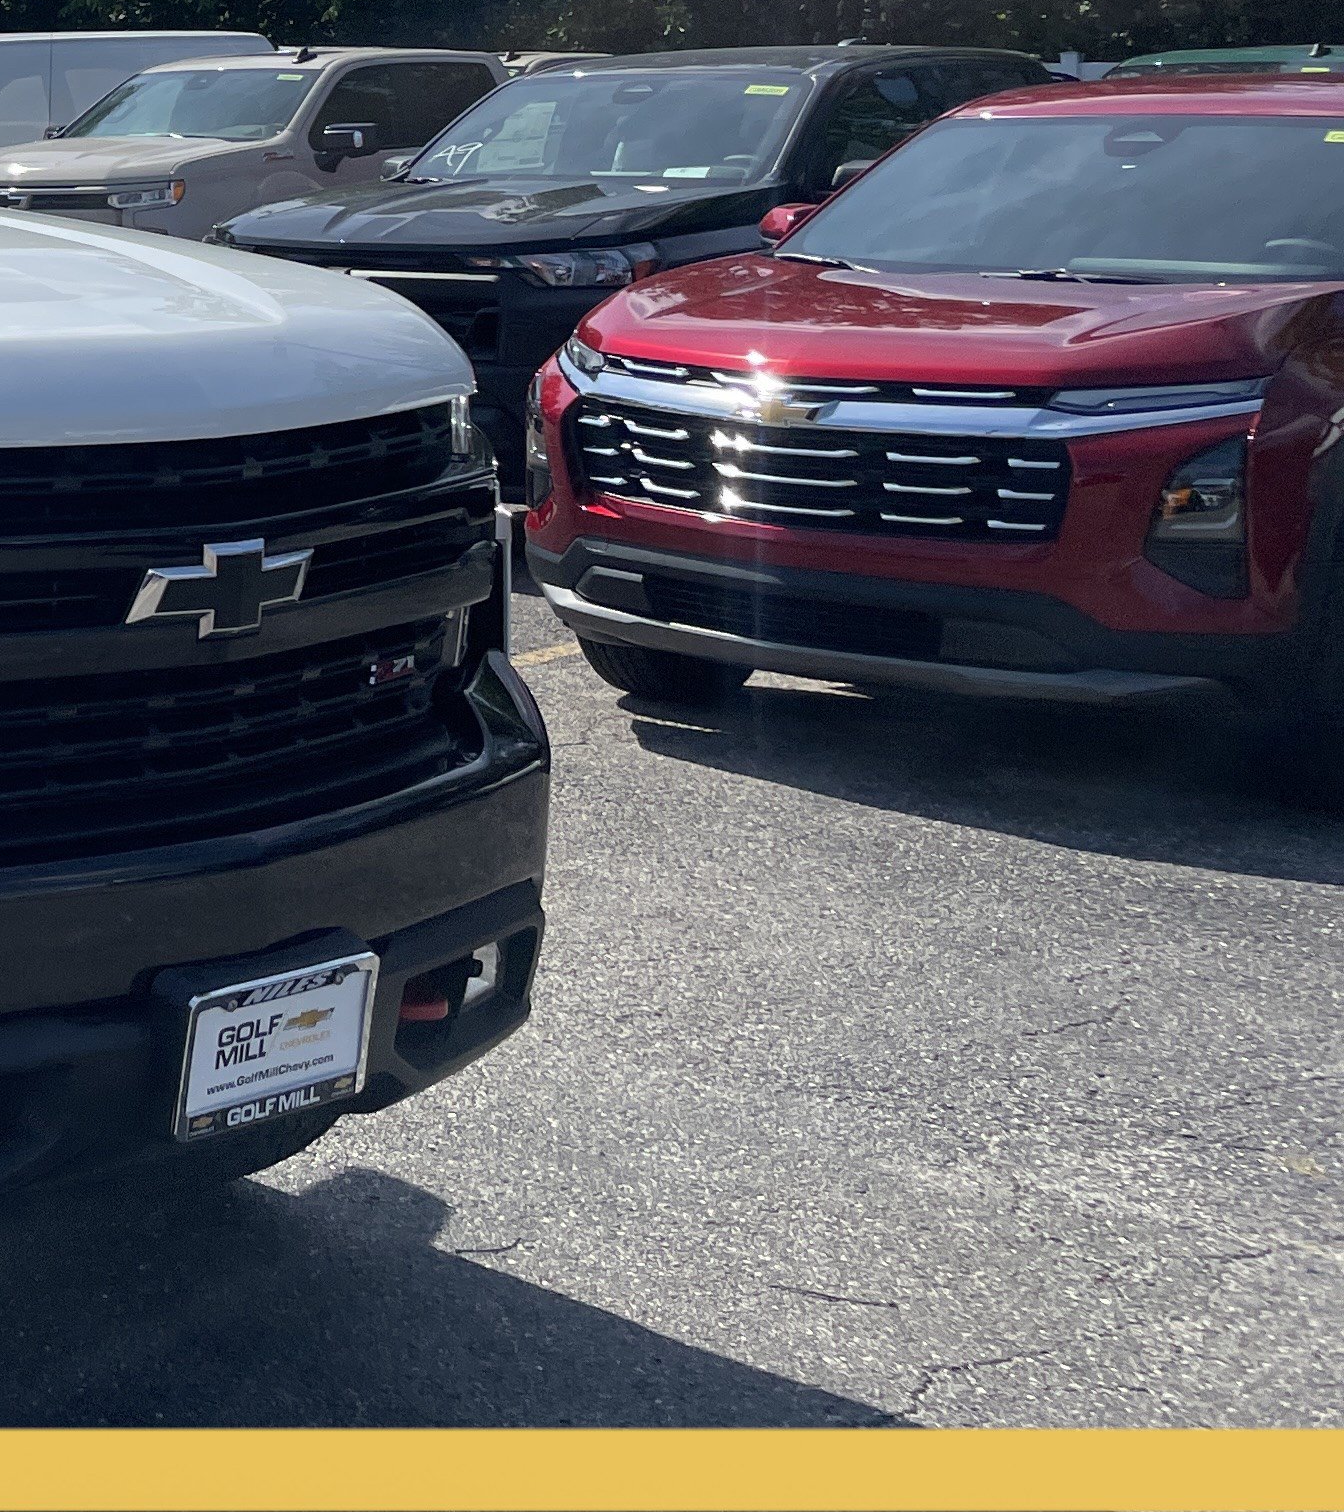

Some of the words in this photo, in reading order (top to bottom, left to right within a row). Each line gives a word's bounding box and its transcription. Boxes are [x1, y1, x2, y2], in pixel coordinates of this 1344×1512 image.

[242, 971, 333, 1006] NILES
[217, 1013, 284, 1048] GOLF
[214, 1037, 267, 1071] MILL
[226, 1097, 277, 1127] GOLF
[278, 1086, 321, 1113] MILL
